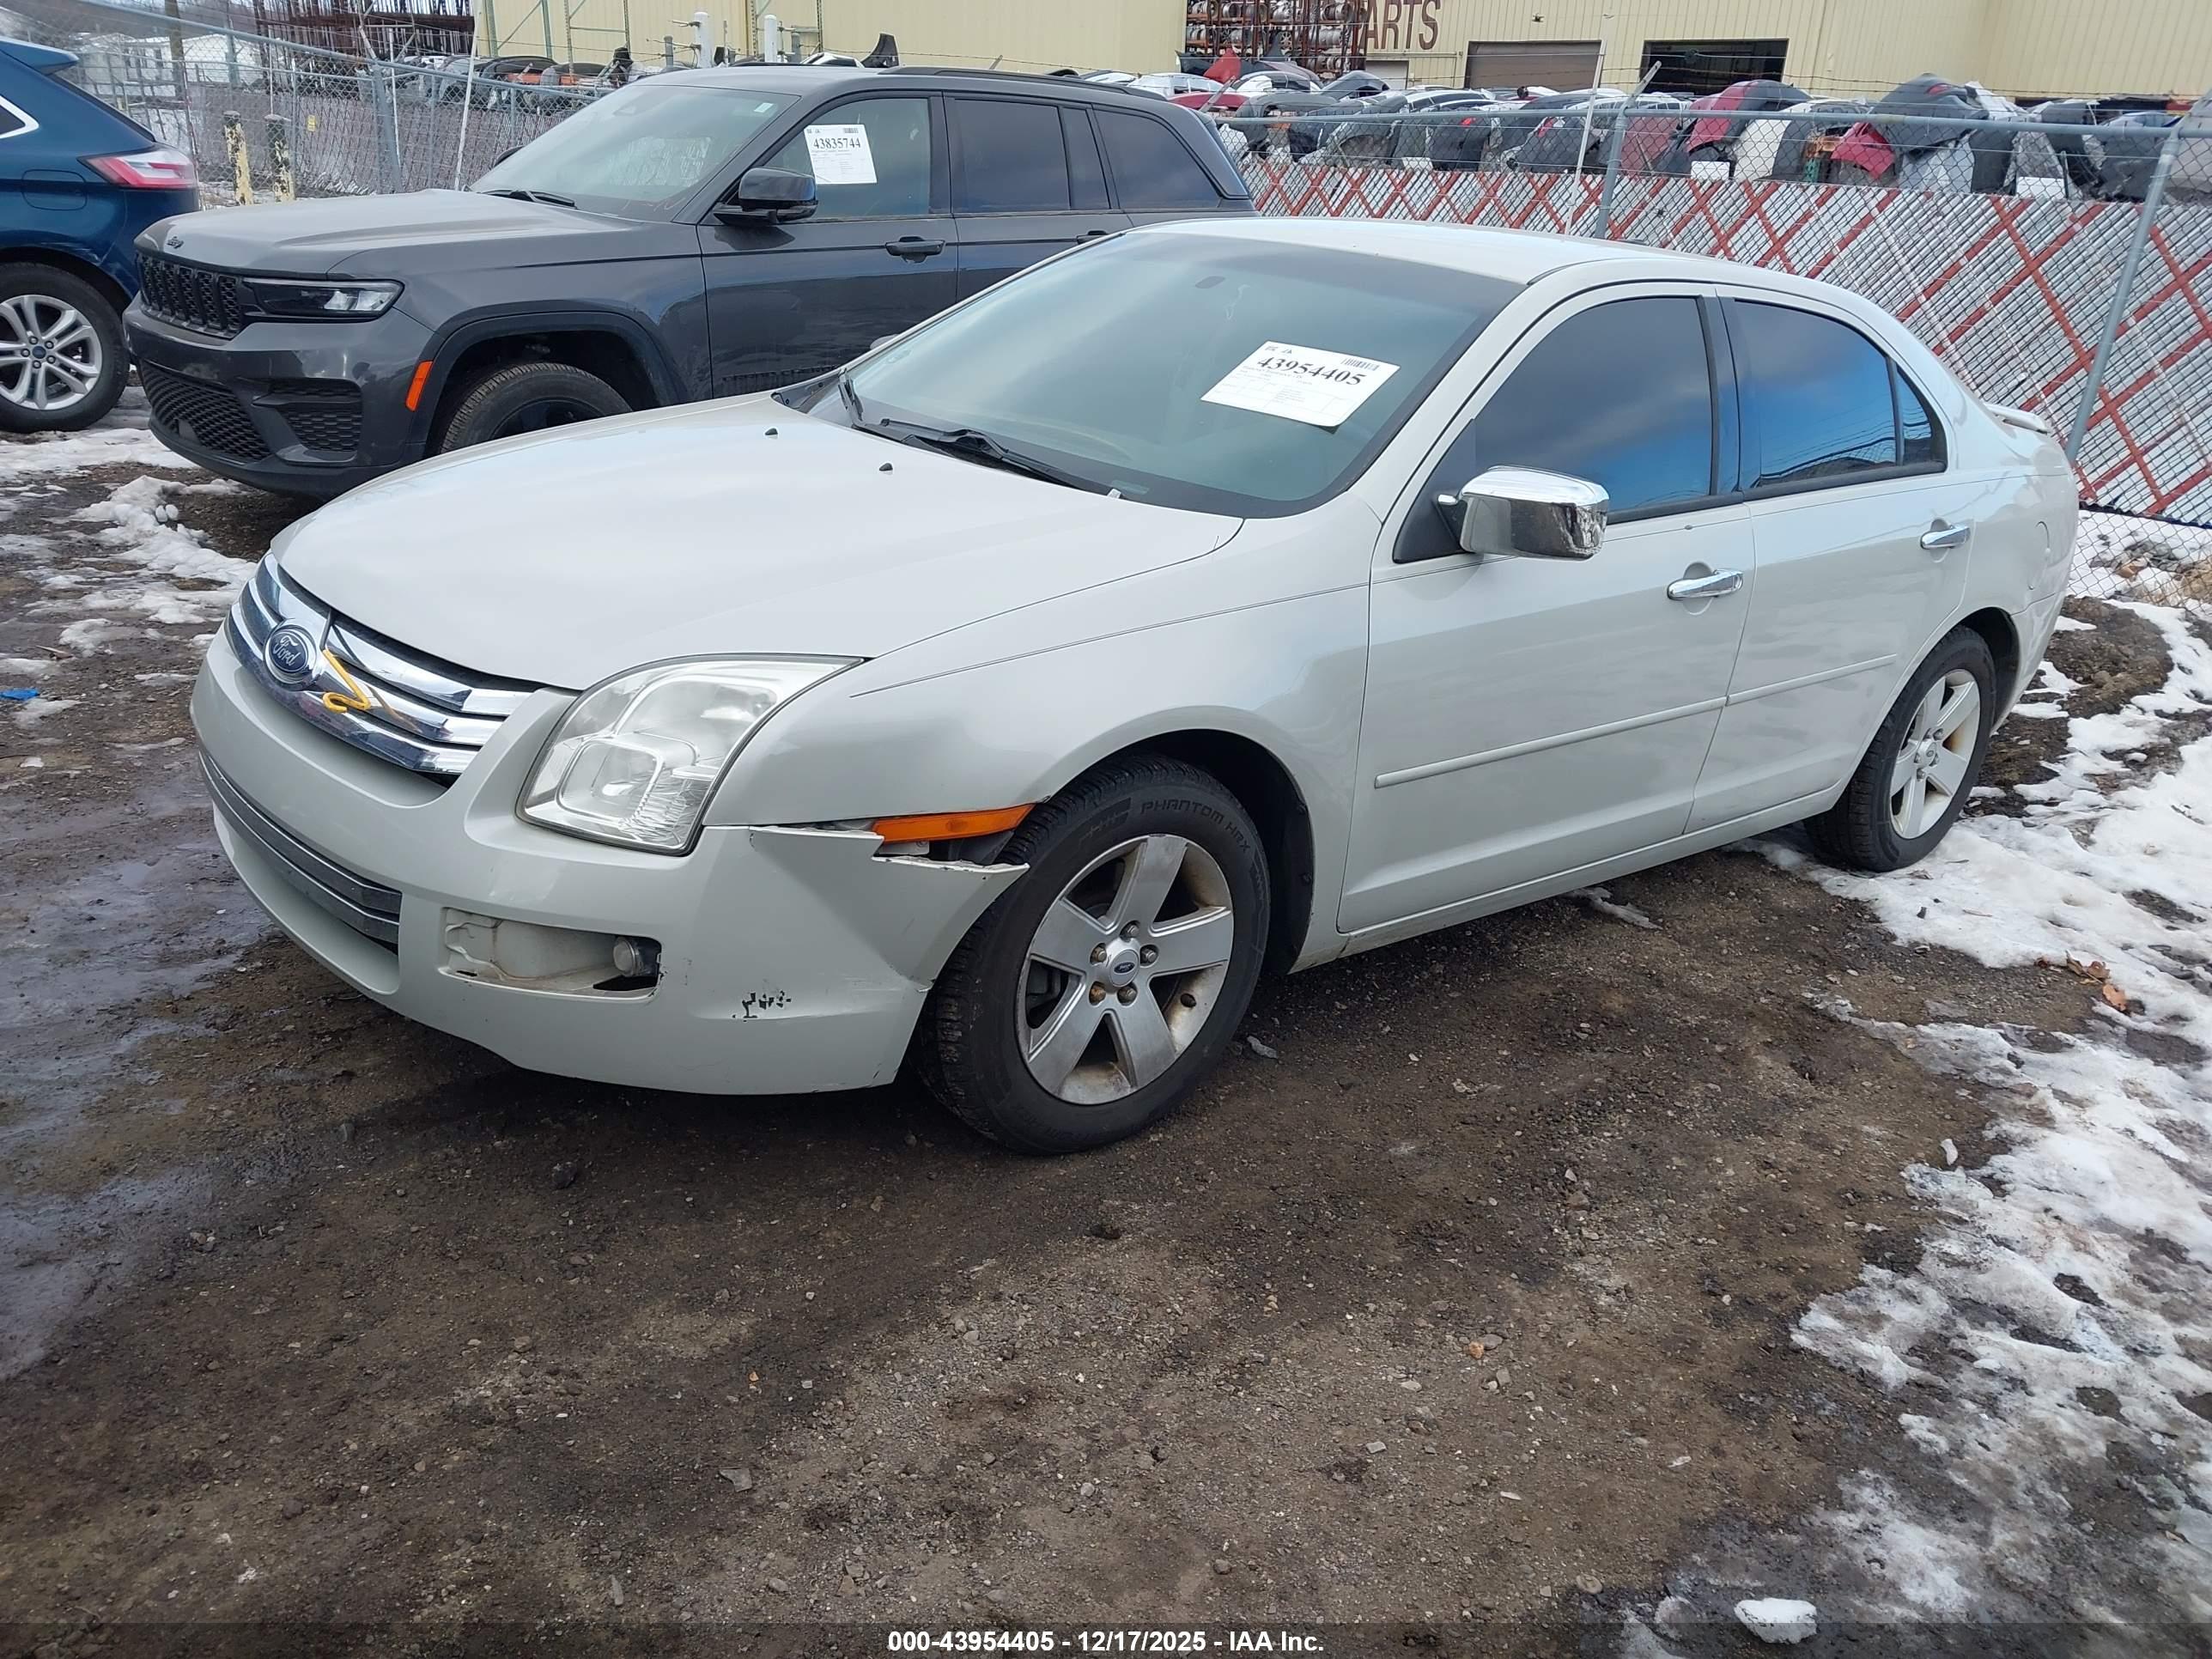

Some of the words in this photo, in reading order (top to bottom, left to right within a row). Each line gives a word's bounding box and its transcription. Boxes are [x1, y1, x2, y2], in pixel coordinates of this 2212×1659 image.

[1357, 0, 1442, 50] ARTS
[813, 137, 861, 149] 43835744
[1256, 356, 1368, 386] 43954405
[272, 635, 301, 666] Ford
[1140, 799, 1224, 824] PHANTOM
[1224, 821, 1251, 853] HRX
